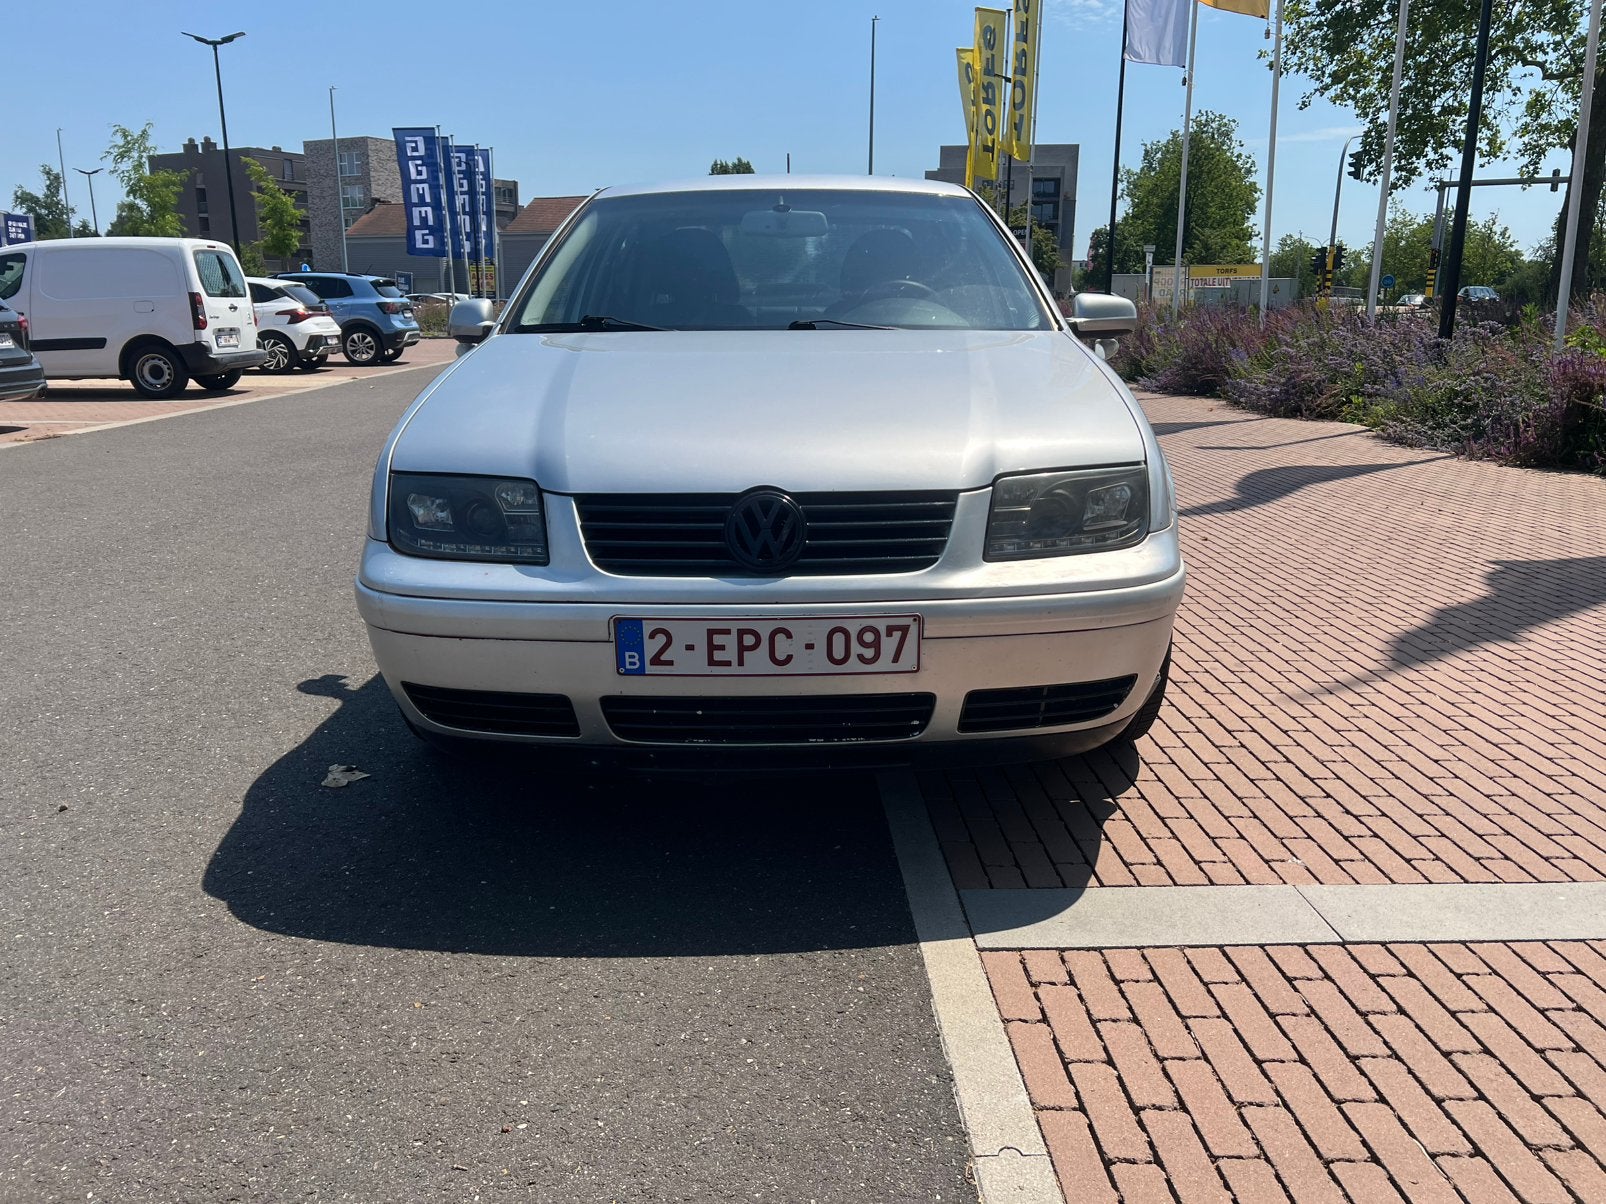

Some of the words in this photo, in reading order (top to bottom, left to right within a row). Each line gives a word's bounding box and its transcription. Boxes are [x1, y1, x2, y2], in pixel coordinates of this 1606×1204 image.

[1215, 267, 1238, 275] TORFS
[1190, 277, 1216, 288] TOTALE
[623, 650, 641, 670] B
[647, 624, 912, 668] 2-EPC-097
